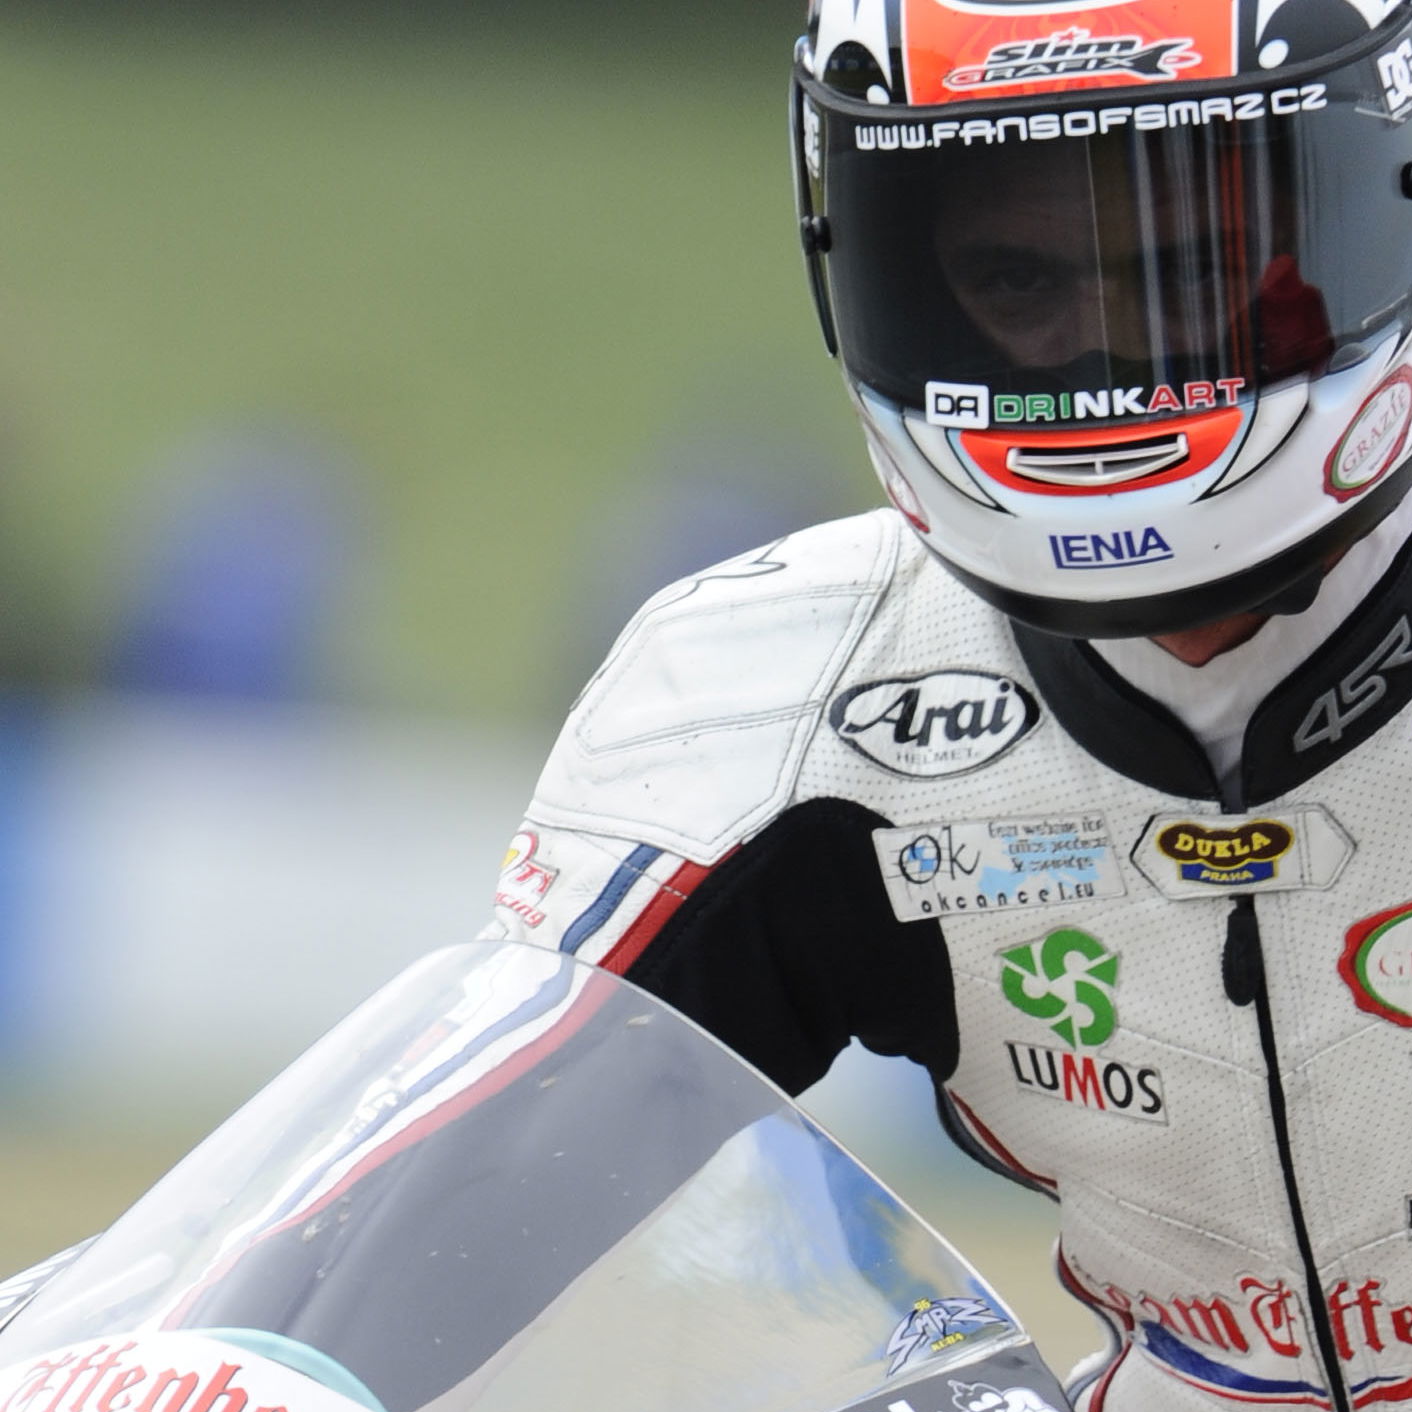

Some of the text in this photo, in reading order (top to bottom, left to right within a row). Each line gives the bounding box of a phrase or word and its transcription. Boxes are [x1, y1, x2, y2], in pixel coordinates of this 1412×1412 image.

[994, 378, 1245, 422] DRINKART
[843, 681, 1014, 747] Arai
[1174, 831, 1272, 858] DUKLA
[1200, 869, 1255, 882] PRAHA
[1008, 1042, 1163, 1114] LUMOS
